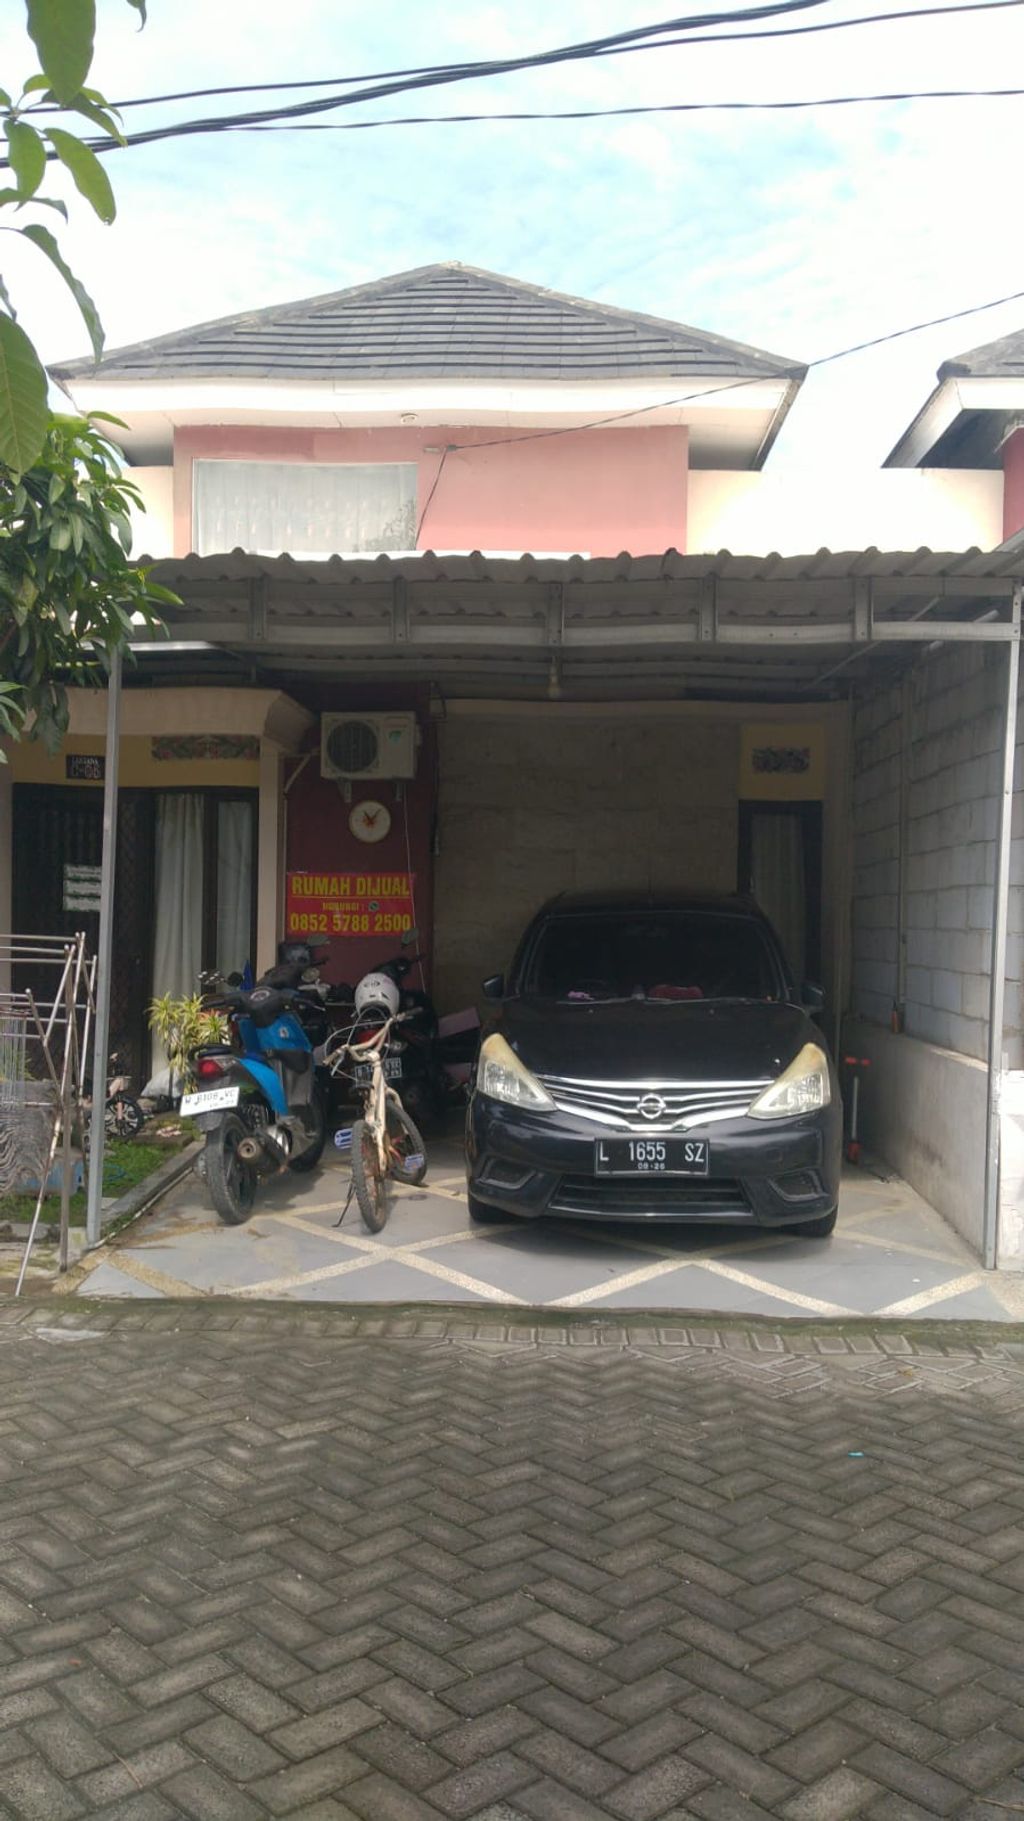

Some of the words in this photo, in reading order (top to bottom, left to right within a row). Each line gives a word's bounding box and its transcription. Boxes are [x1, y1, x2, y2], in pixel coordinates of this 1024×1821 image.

[292, 876, 350, 896] RUMAH
[356, 877, 409, 897] DIJUAL
[290, 913, 327, 932] 0852
[332, 914, 369, 932] 5788
[374, 914, 411, 932] 2500
[600, 1140, 609, 1161] L
[629, 1141, 667, 1161] 1655
[684, 1142, 705, 1163] SZ
